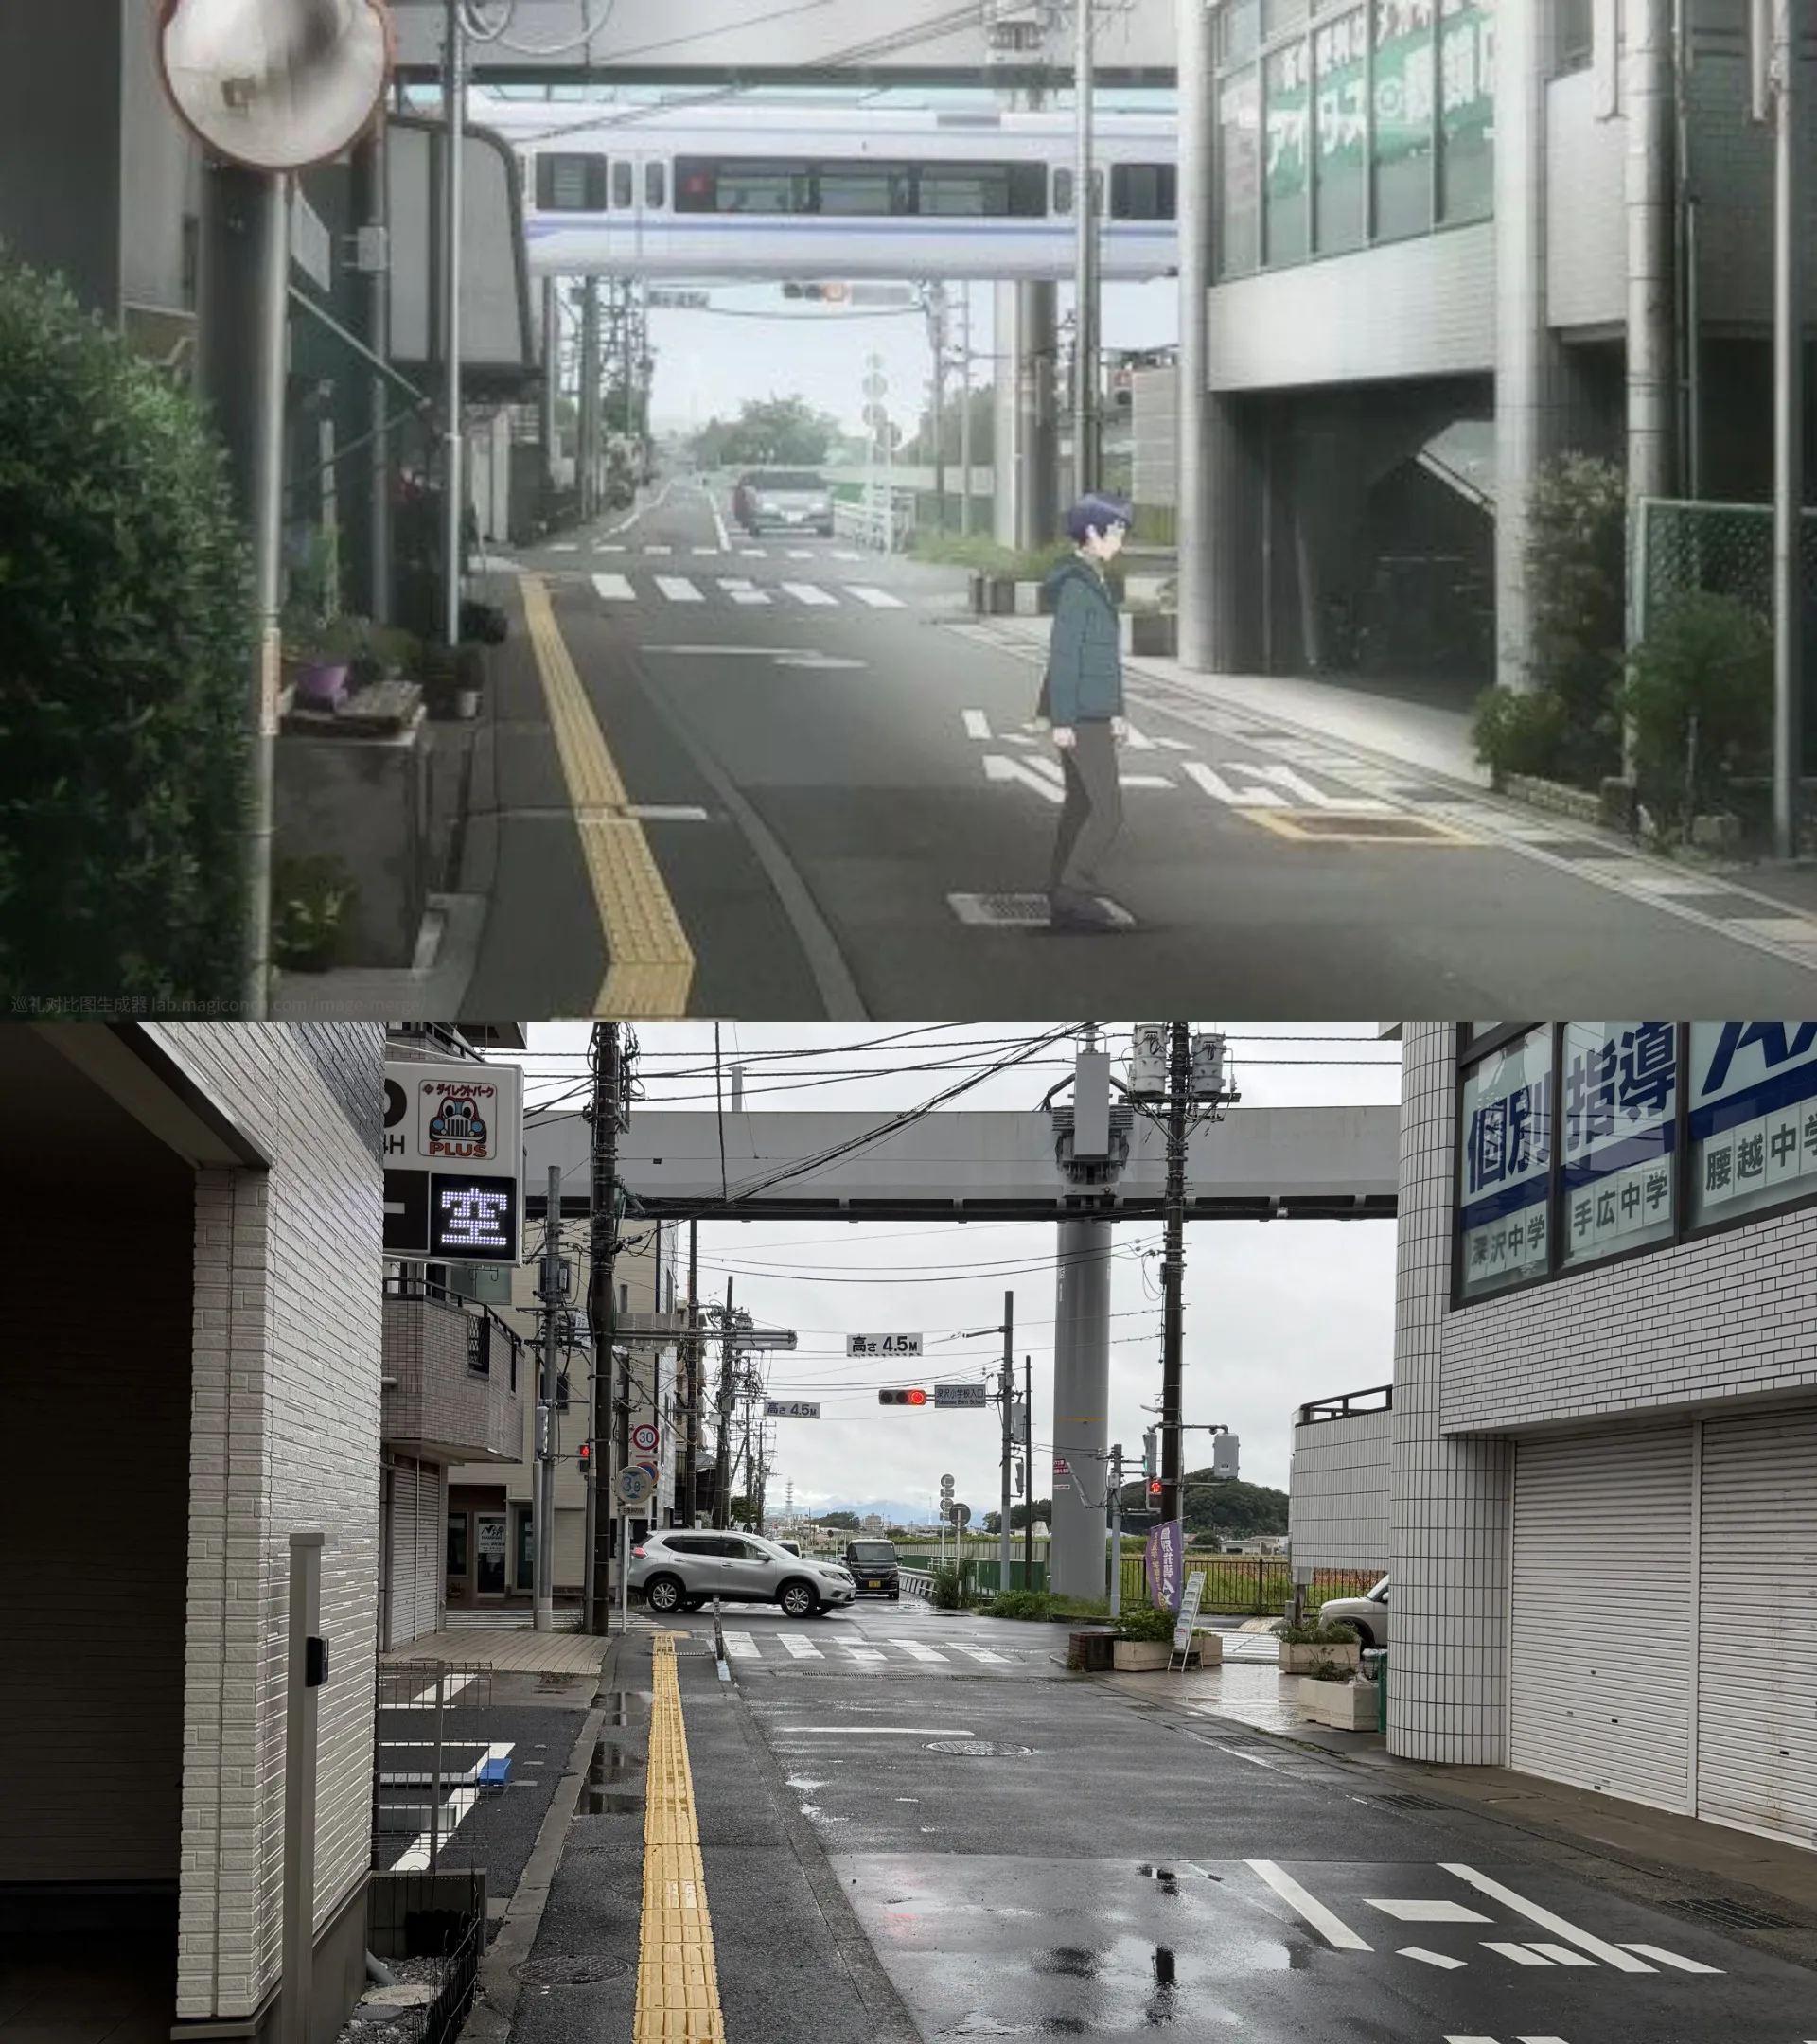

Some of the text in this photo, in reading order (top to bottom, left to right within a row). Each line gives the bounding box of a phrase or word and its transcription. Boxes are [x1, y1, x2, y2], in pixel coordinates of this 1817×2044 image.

[436, 1083, 494, 1098] ダイレクトパーク
[1467, 1022, 1675, 1194] 個別指導
[429, 1141, 487, 1157] PLUS
[1573, 1168, 1667, 1236] 手広中学
[441, 1187, 507, 1245] 空
[1471, 1214, 1544, 1265] 深沢中学
[852, 1335, 918, 1352] 高さ 4.5M
[767, 1402, 817, 1417] 高さ 4.5M
[639, 1432, 654, 1444] 30
